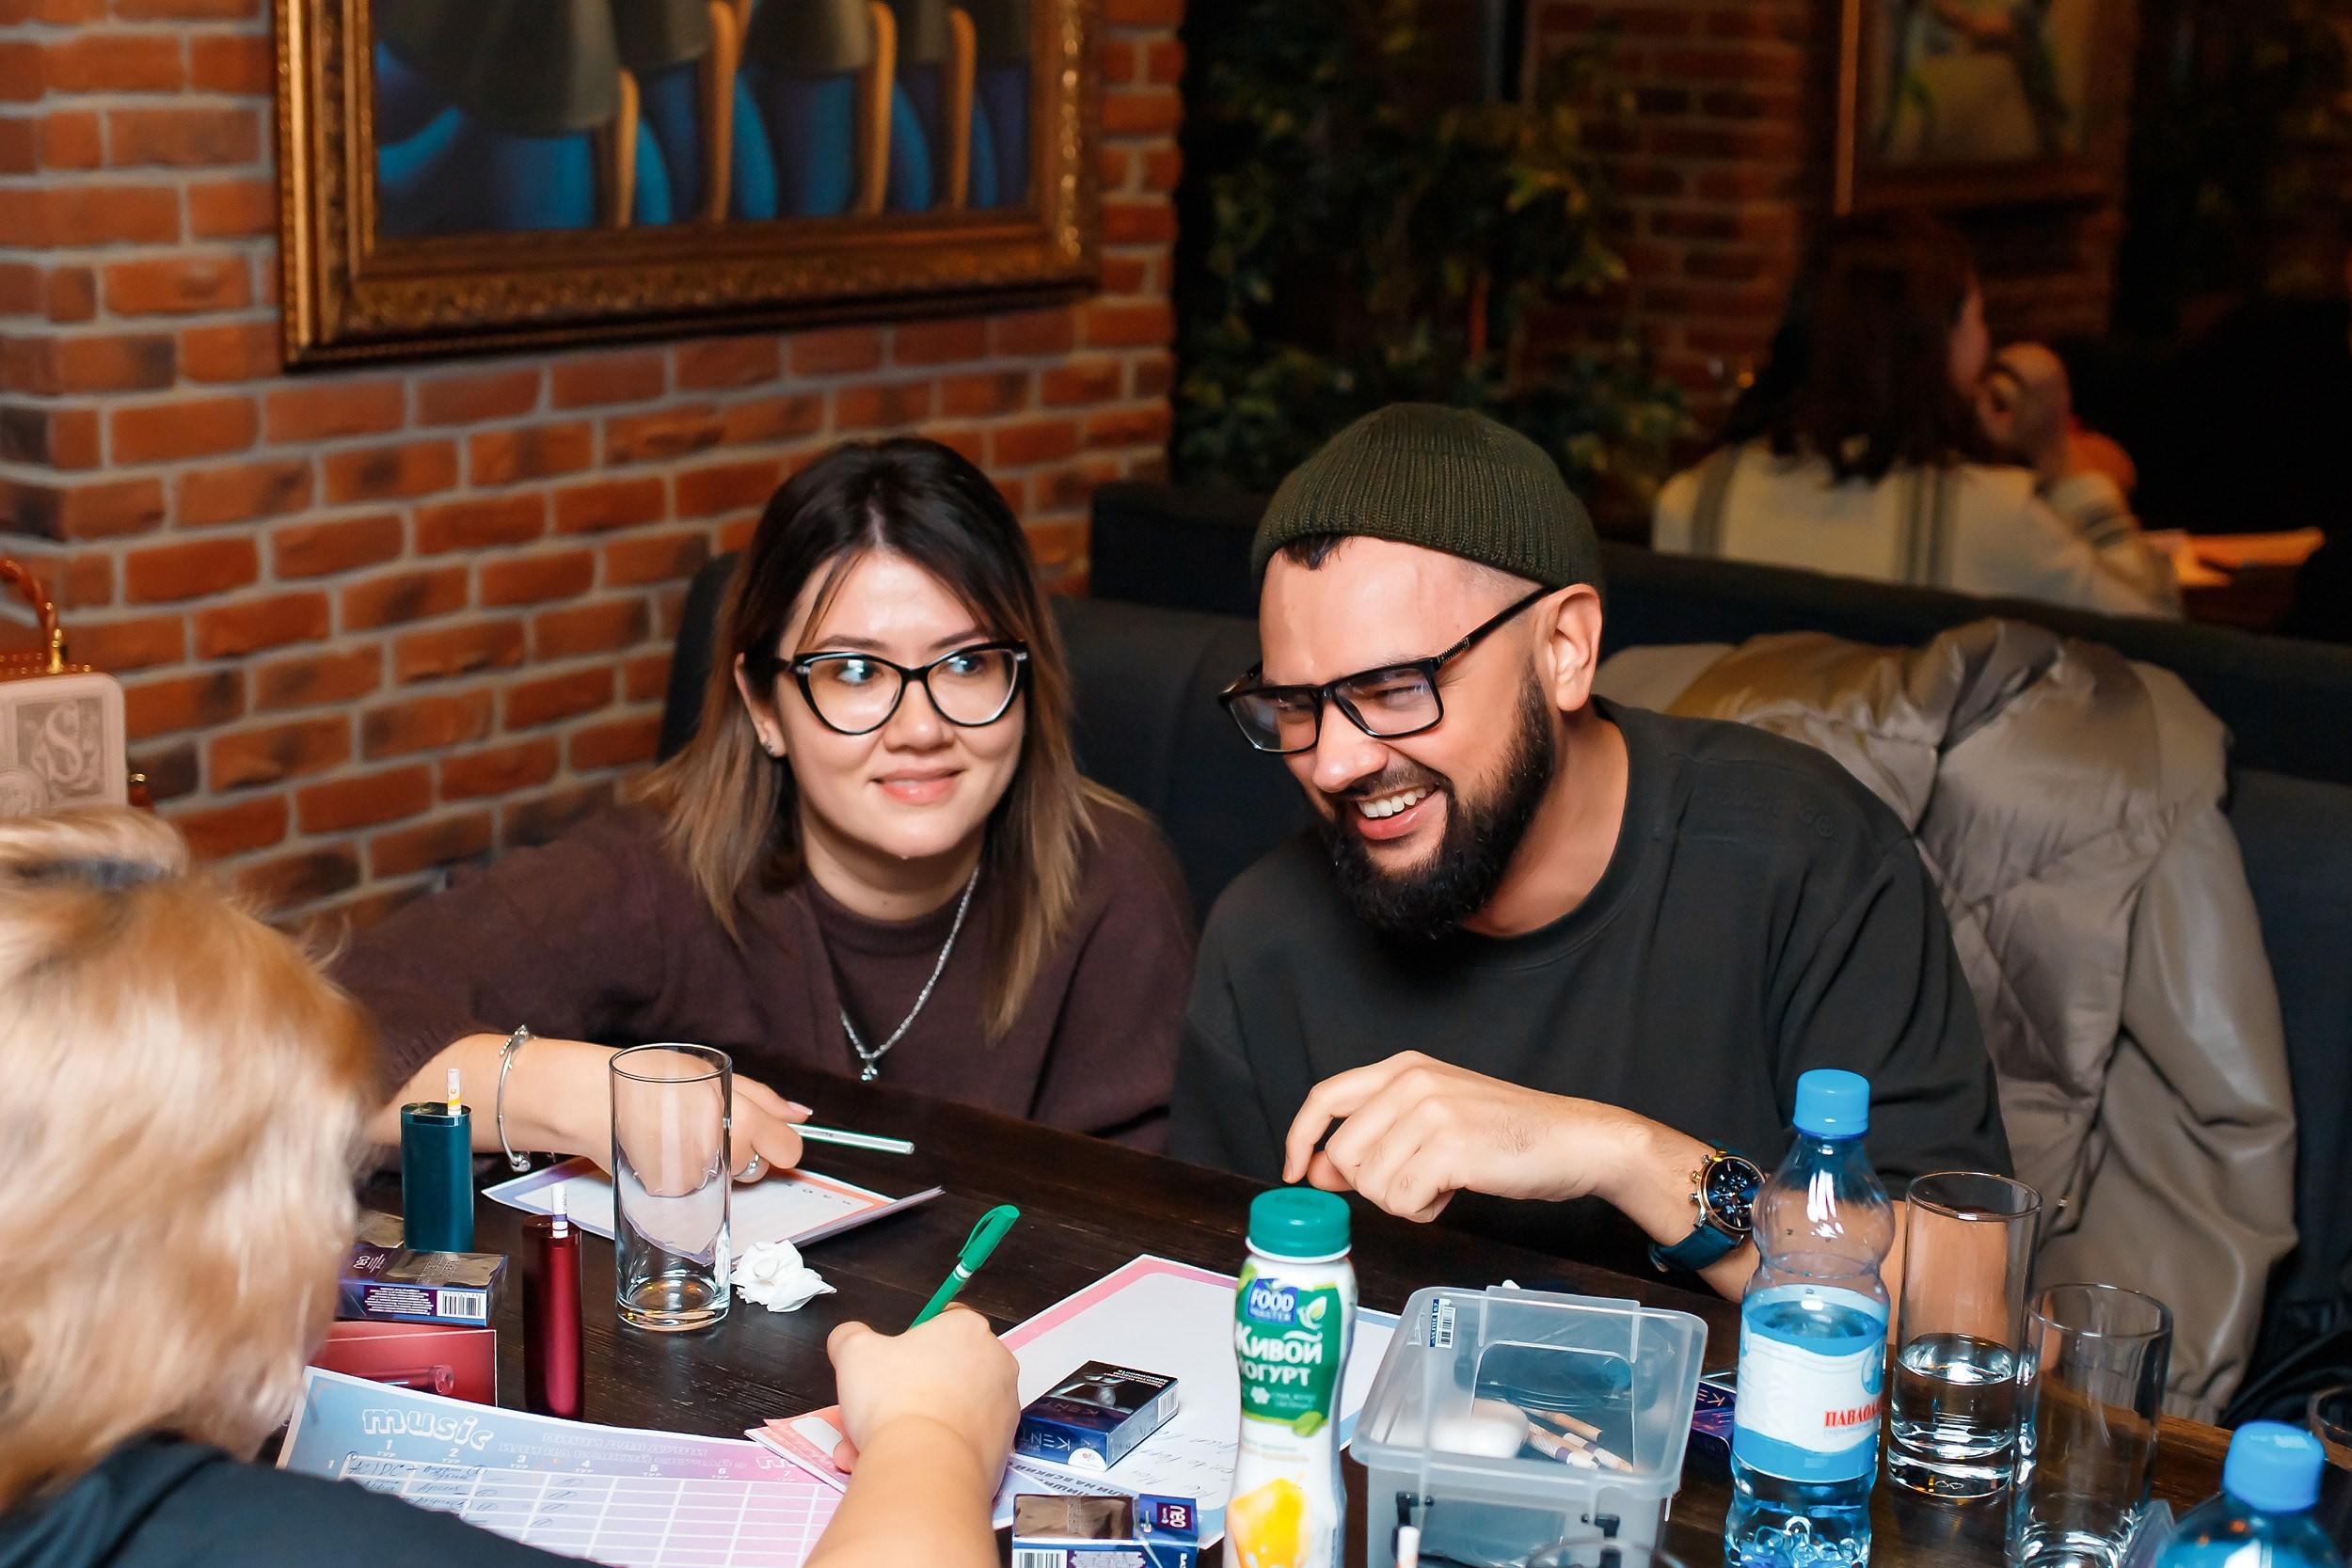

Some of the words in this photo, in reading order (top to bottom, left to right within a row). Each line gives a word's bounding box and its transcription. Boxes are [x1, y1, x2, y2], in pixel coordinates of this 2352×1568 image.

[1250, 1288, 1295, 1313] FOOD
[361, 1408, 494, 1451] music
[1019, 1427, 1072, 1451] KENT
[386, 1439, 393, 1450] 1
[449, 1448, 459, 1457] 2
[516, 1454, 527, 1464] 3
[580, 1459, 591, 1468] 4
[649, 1464, 659, 1472] 5
[1074, 1480, 1097, 1490] НА
[1169, 1505, 1186, 1528] neo
